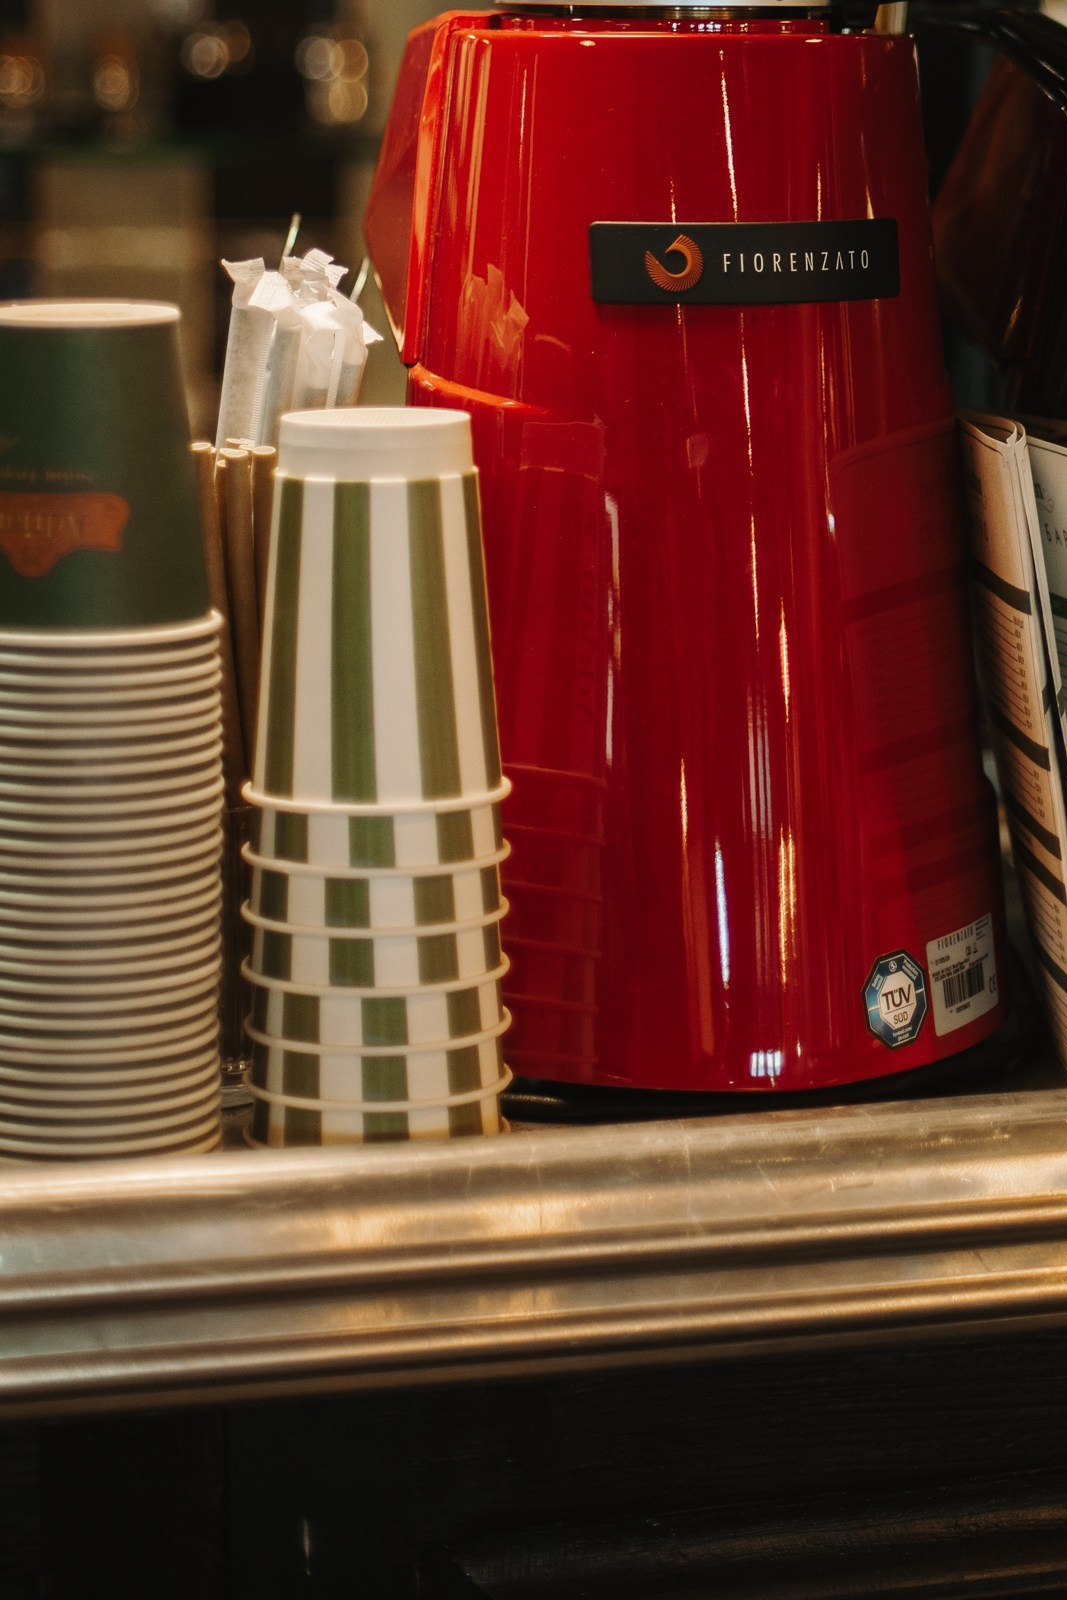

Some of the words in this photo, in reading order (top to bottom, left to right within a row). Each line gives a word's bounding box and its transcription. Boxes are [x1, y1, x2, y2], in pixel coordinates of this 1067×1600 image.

[723, 249, 870, 273] FIORENZATO
[881, 983, 912, 1011] TÜV
[893, 1010, 909, 1025] SÜD
